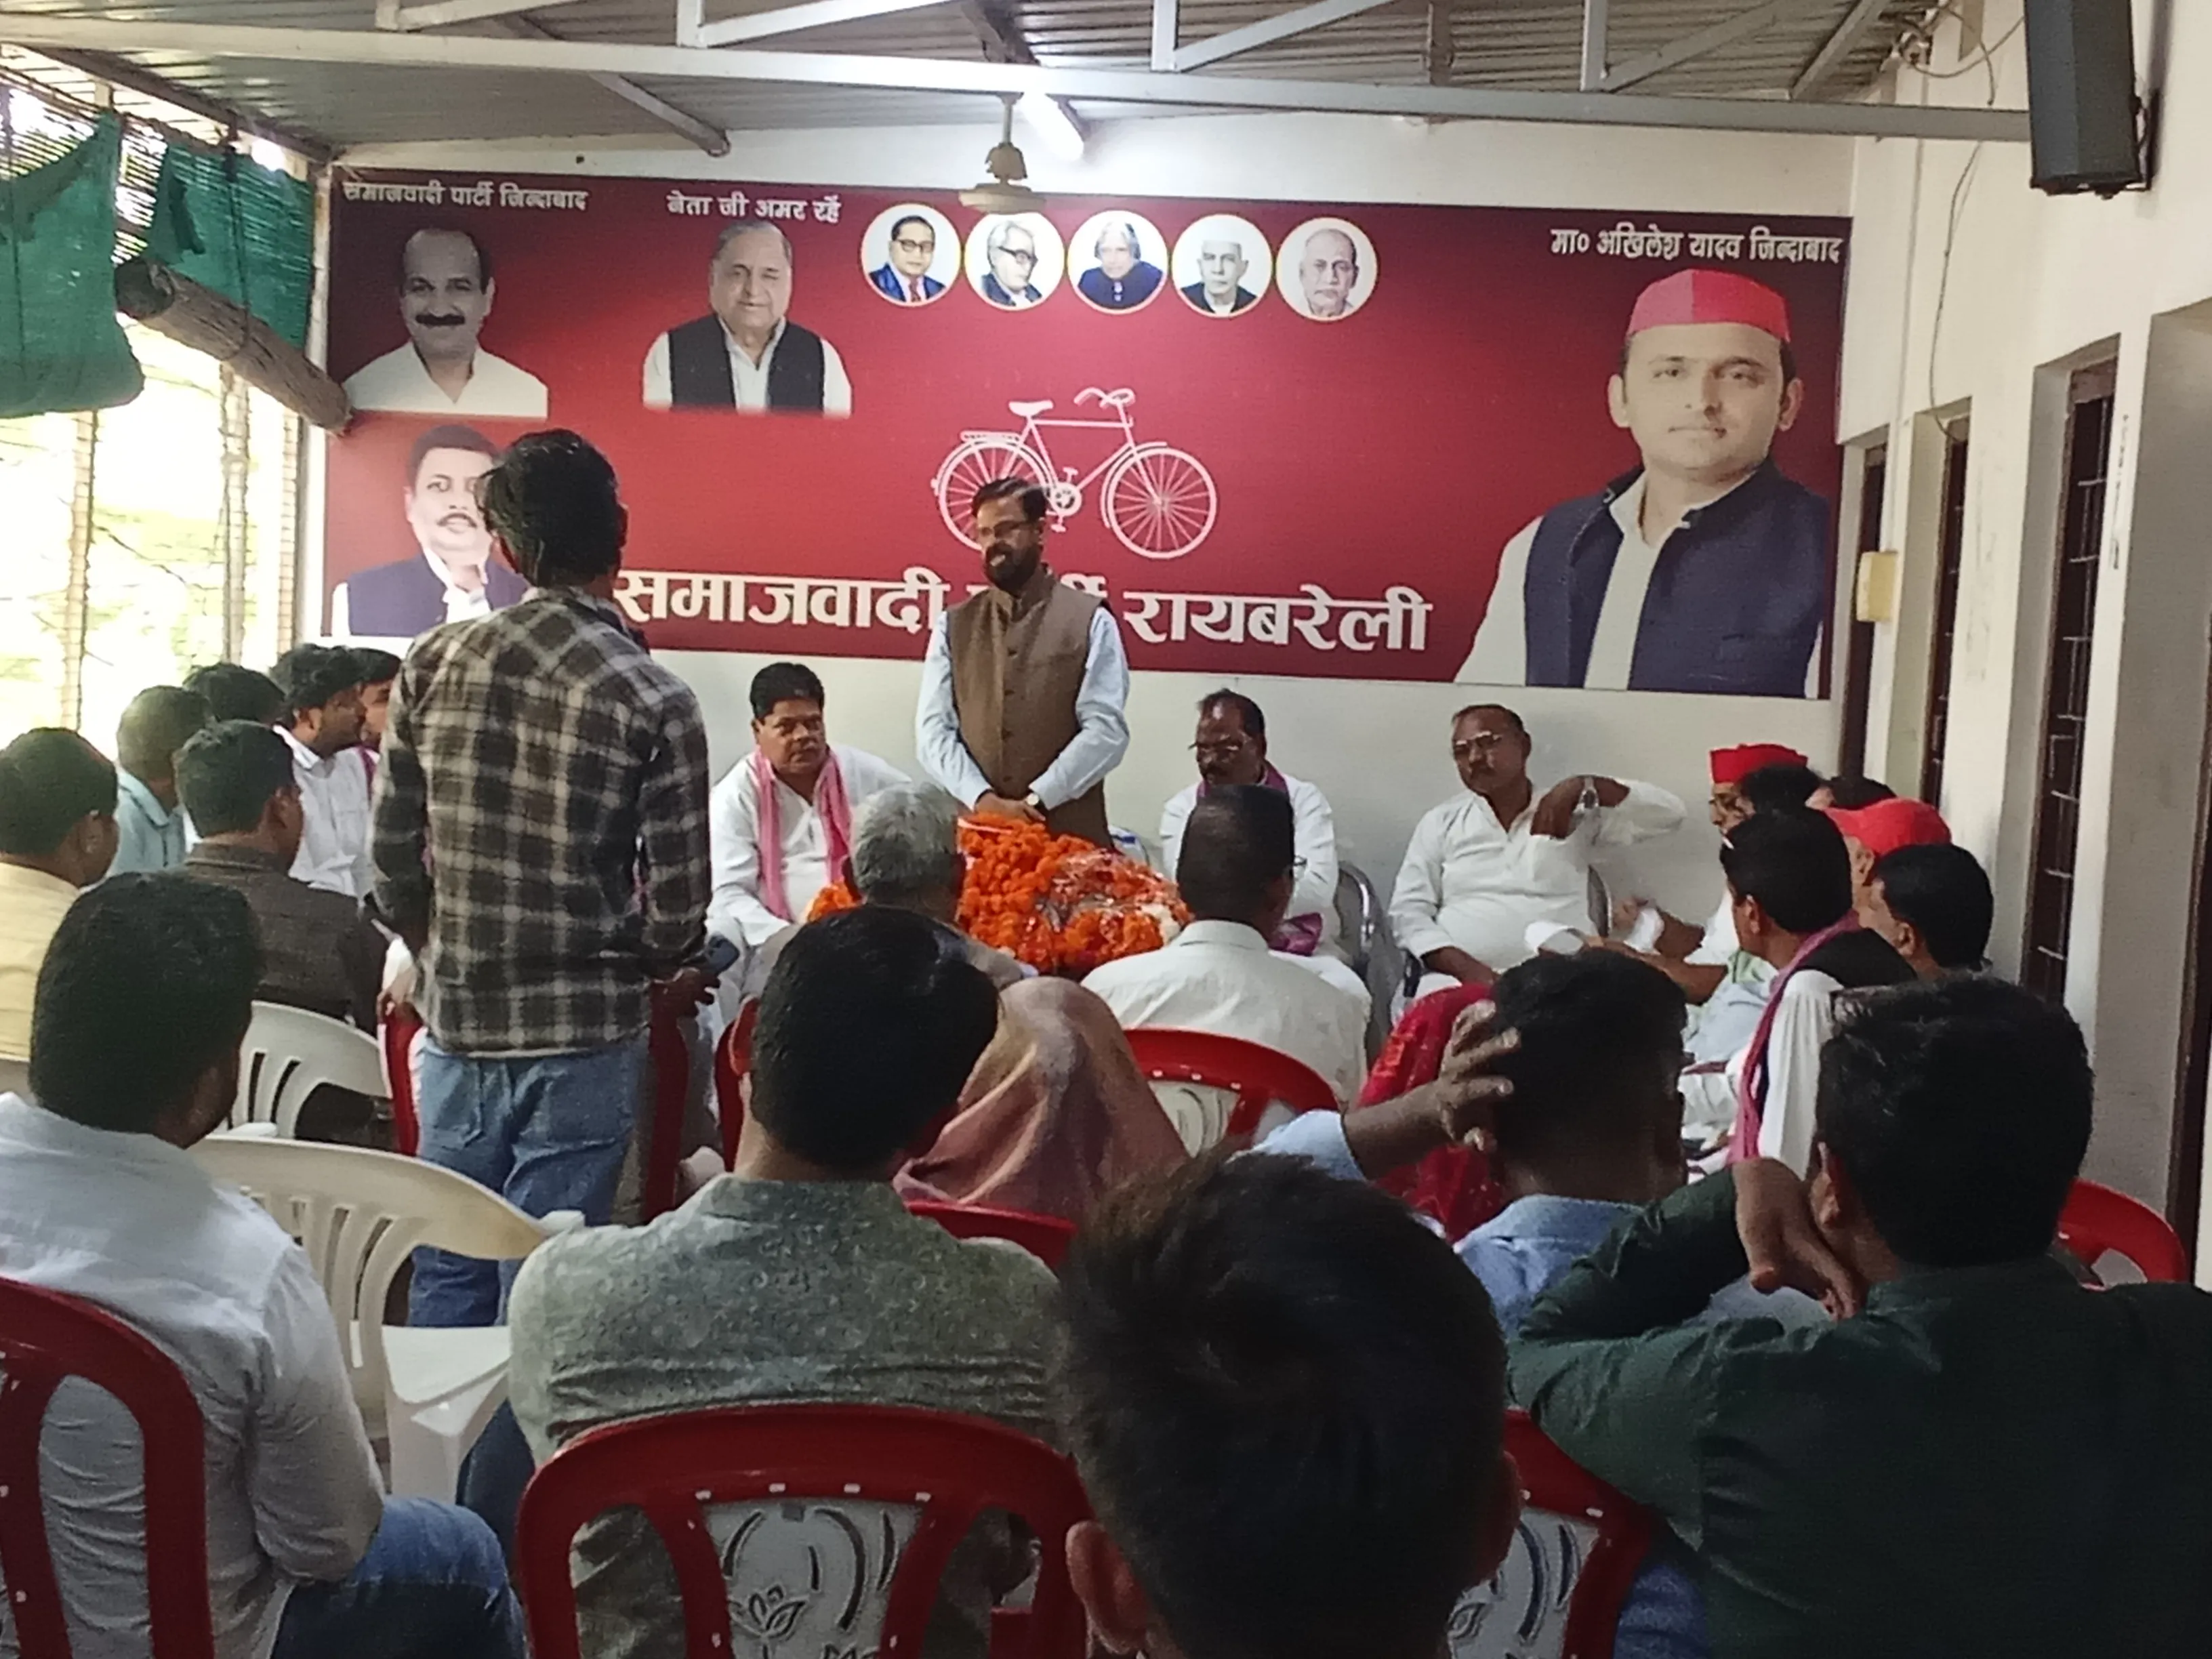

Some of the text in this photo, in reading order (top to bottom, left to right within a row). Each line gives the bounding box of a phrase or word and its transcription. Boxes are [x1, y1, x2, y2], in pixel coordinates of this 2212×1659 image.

[343, 180, 588, 211] समाजवादी पार्टी जिन्दाबाद
[666, 190, 713, 215] नेता
[717, 190, 750, 217] जी
[755, 199, 807, 220] अमर
[1597, 222, 1684, 259] अखिलेश
[1688, 232, 1744, 260] यादव
[1749, 225, 1843, 263] जिन्दाबाद
[613, 567, 951, 634] समाजवादी
[1124, 583, 1433, 651] रायबरेली
